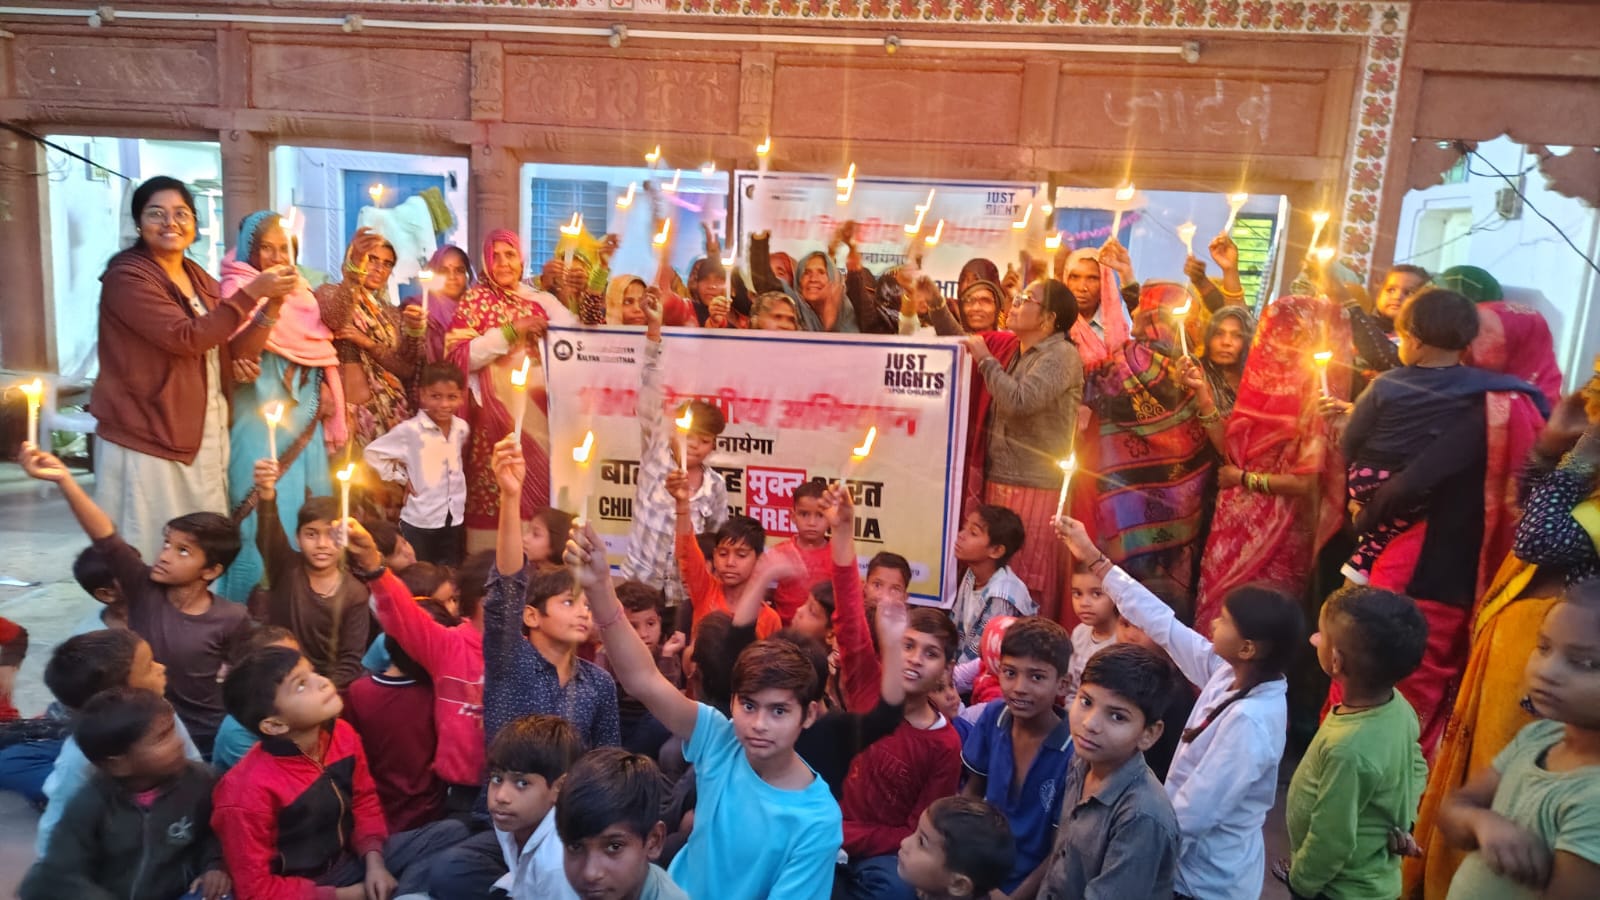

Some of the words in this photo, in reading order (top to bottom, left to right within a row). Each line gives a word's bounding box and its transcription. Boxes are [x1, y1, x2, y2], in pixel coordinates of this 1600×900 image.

[987, 192, 1015, 204] JUST
[885, 353, 927, 370] JUST
[884, 370, 944, 389] RIGHTS
